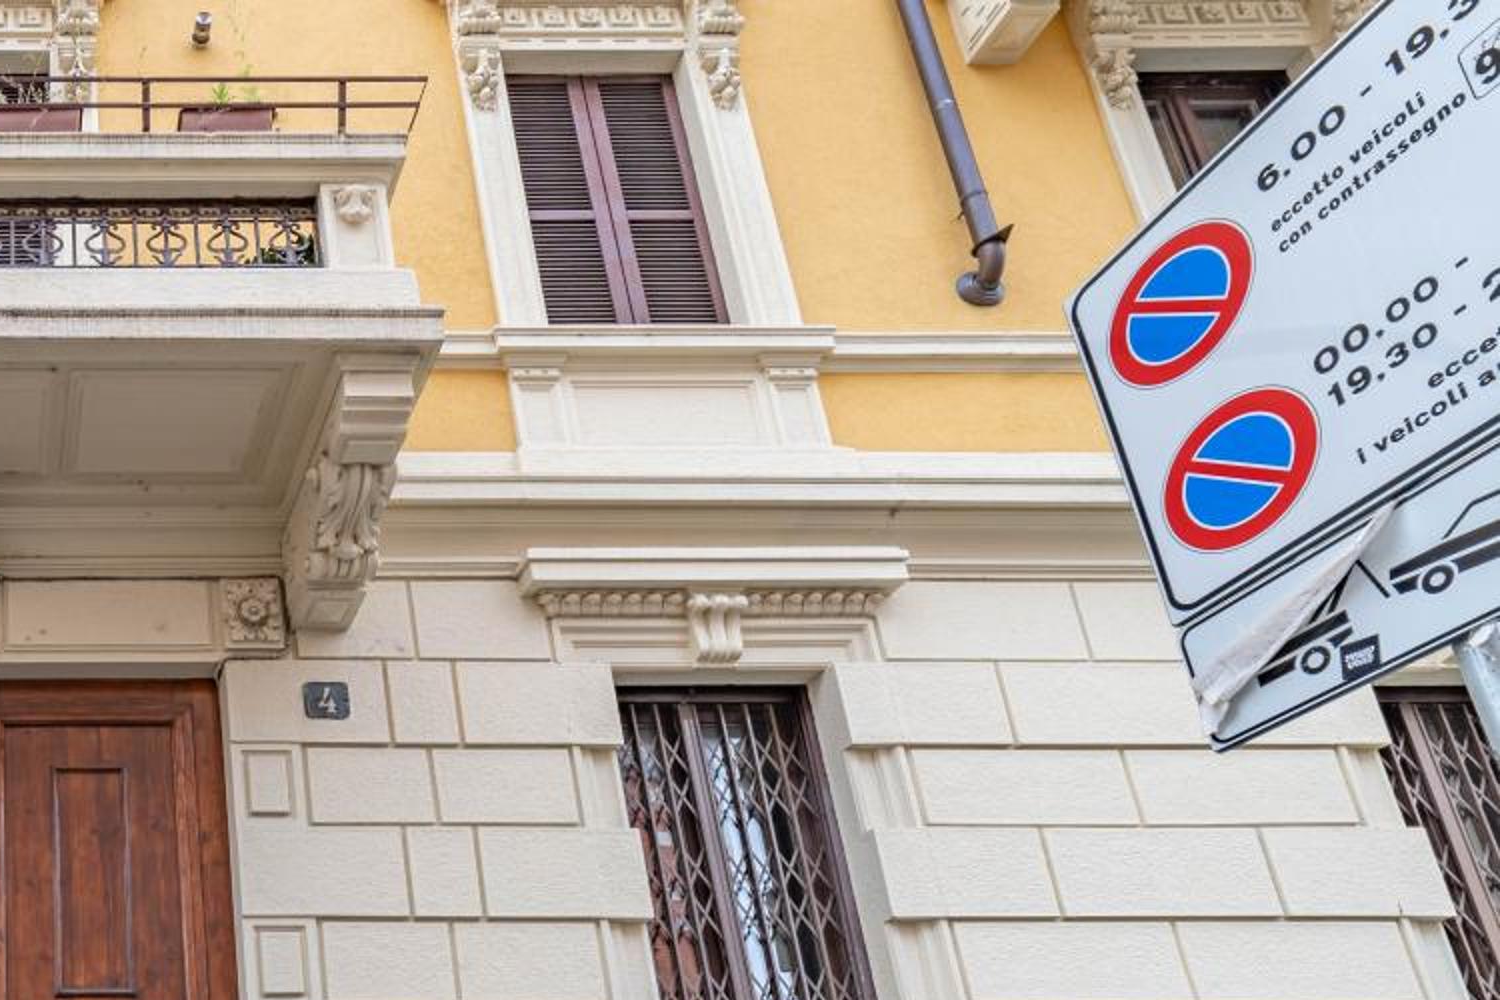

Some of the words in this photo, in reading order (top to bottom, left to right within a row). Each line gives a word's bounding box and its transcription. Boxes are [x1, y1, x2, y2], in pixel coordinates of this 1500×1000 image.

[1257, 105, 1345, 192] 6.00
[1270, 165, 1344, 233] eccetto
[1349, 91, 1425, 164] veicoli
[1279, 220, 1313, 253] con
[1317, 92, 1467, 221] contrassegno
[1313, 275, 1439, 375] 00.00
[1327, 322, 1438, 407] 19.30
[1356, 447, 1367, 465] i
[1373, 381, 1469, 451] veicoli
[318, 687, 337, 713] 4
